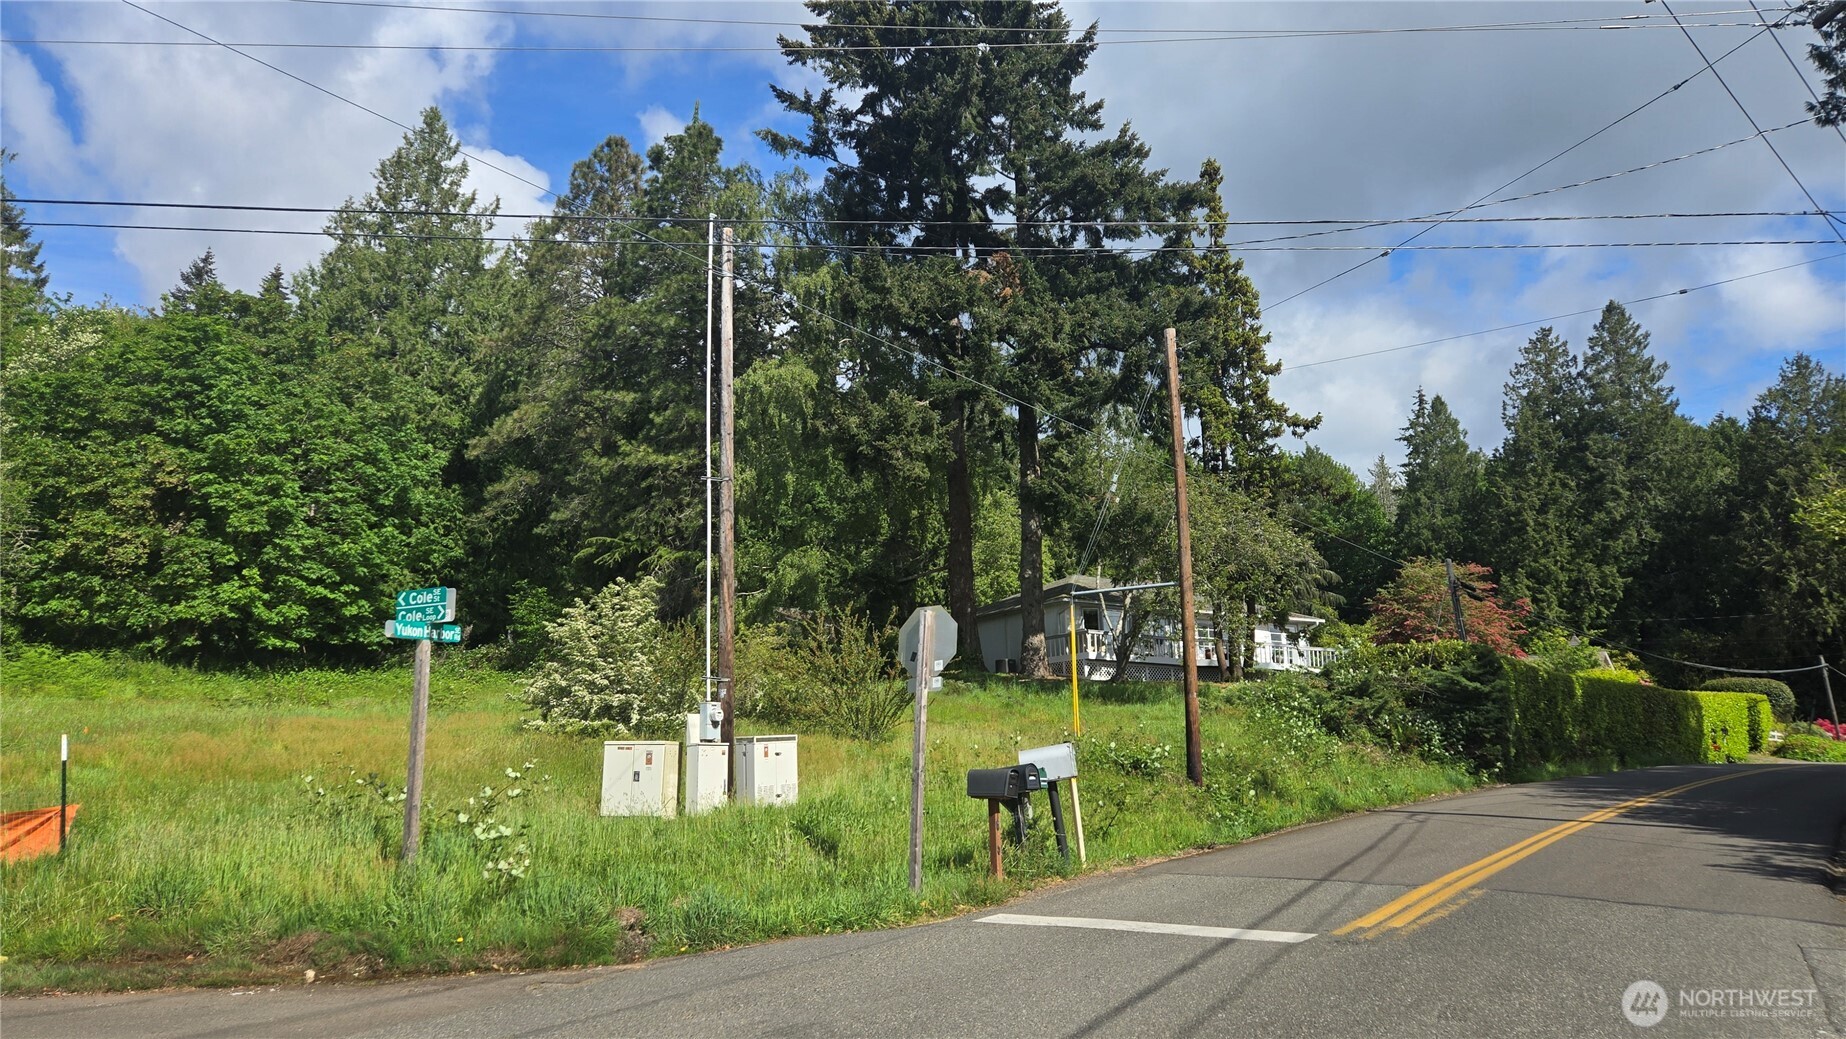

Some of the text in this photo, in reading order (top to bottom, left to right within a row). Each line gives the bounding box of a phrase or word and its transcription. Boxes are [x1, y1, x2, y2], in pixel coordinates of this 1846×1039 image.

[409, 592, 433, 604] Cole
[398, 610, 422, 621] Cole
[395, 622, 423, 637] Yukon
[423, 625, 454, 640] Harbor
